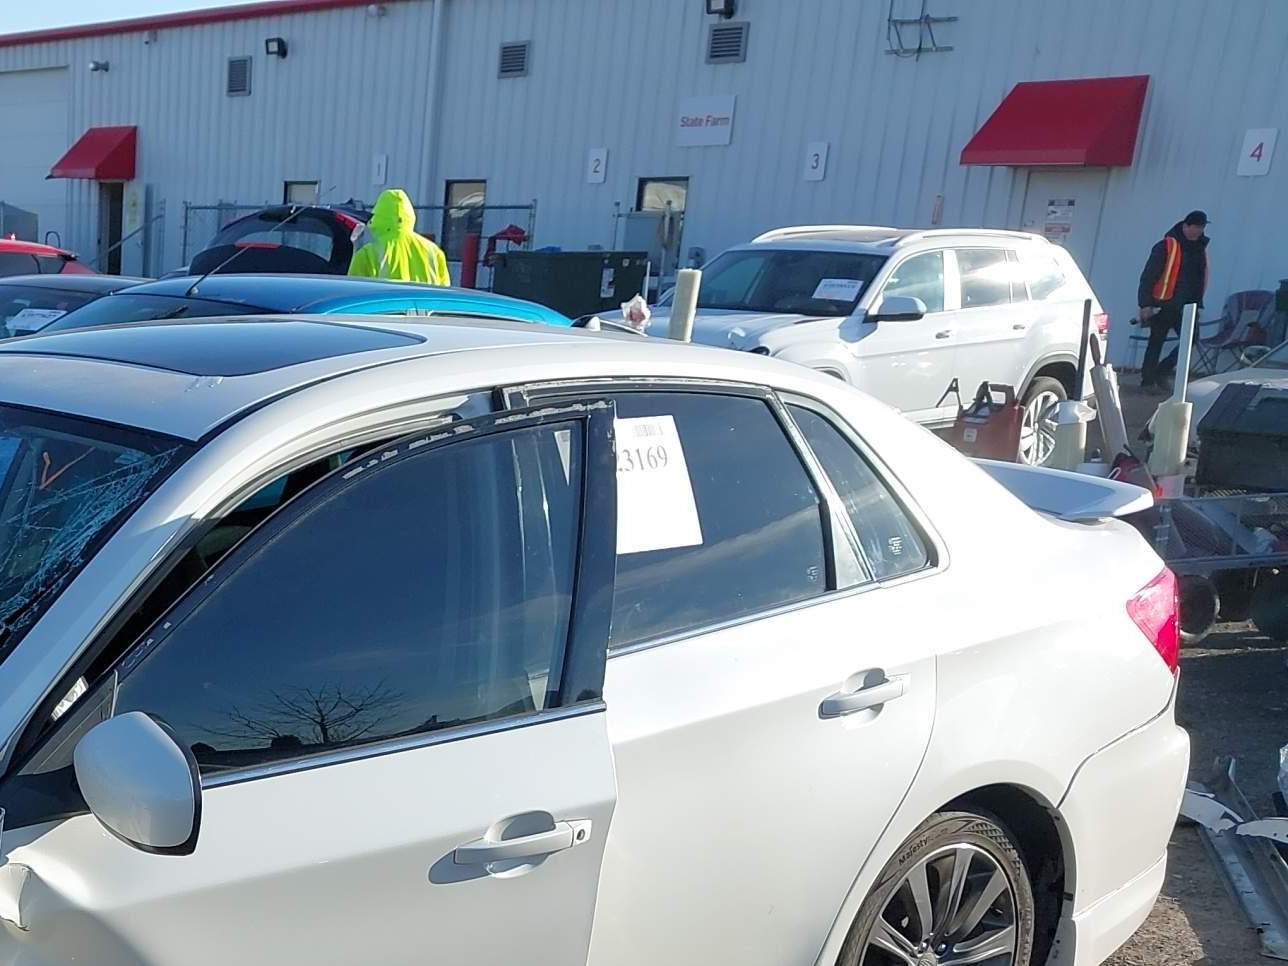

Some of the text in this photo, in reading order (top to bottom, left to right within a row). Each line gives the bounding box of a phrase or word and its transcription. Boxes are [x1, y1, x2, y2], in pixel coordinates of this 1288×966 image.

[1249, 141, 1264, 162] 4
[592, 157, 601, 174] 2
[811, 152, 820, 170] 3
